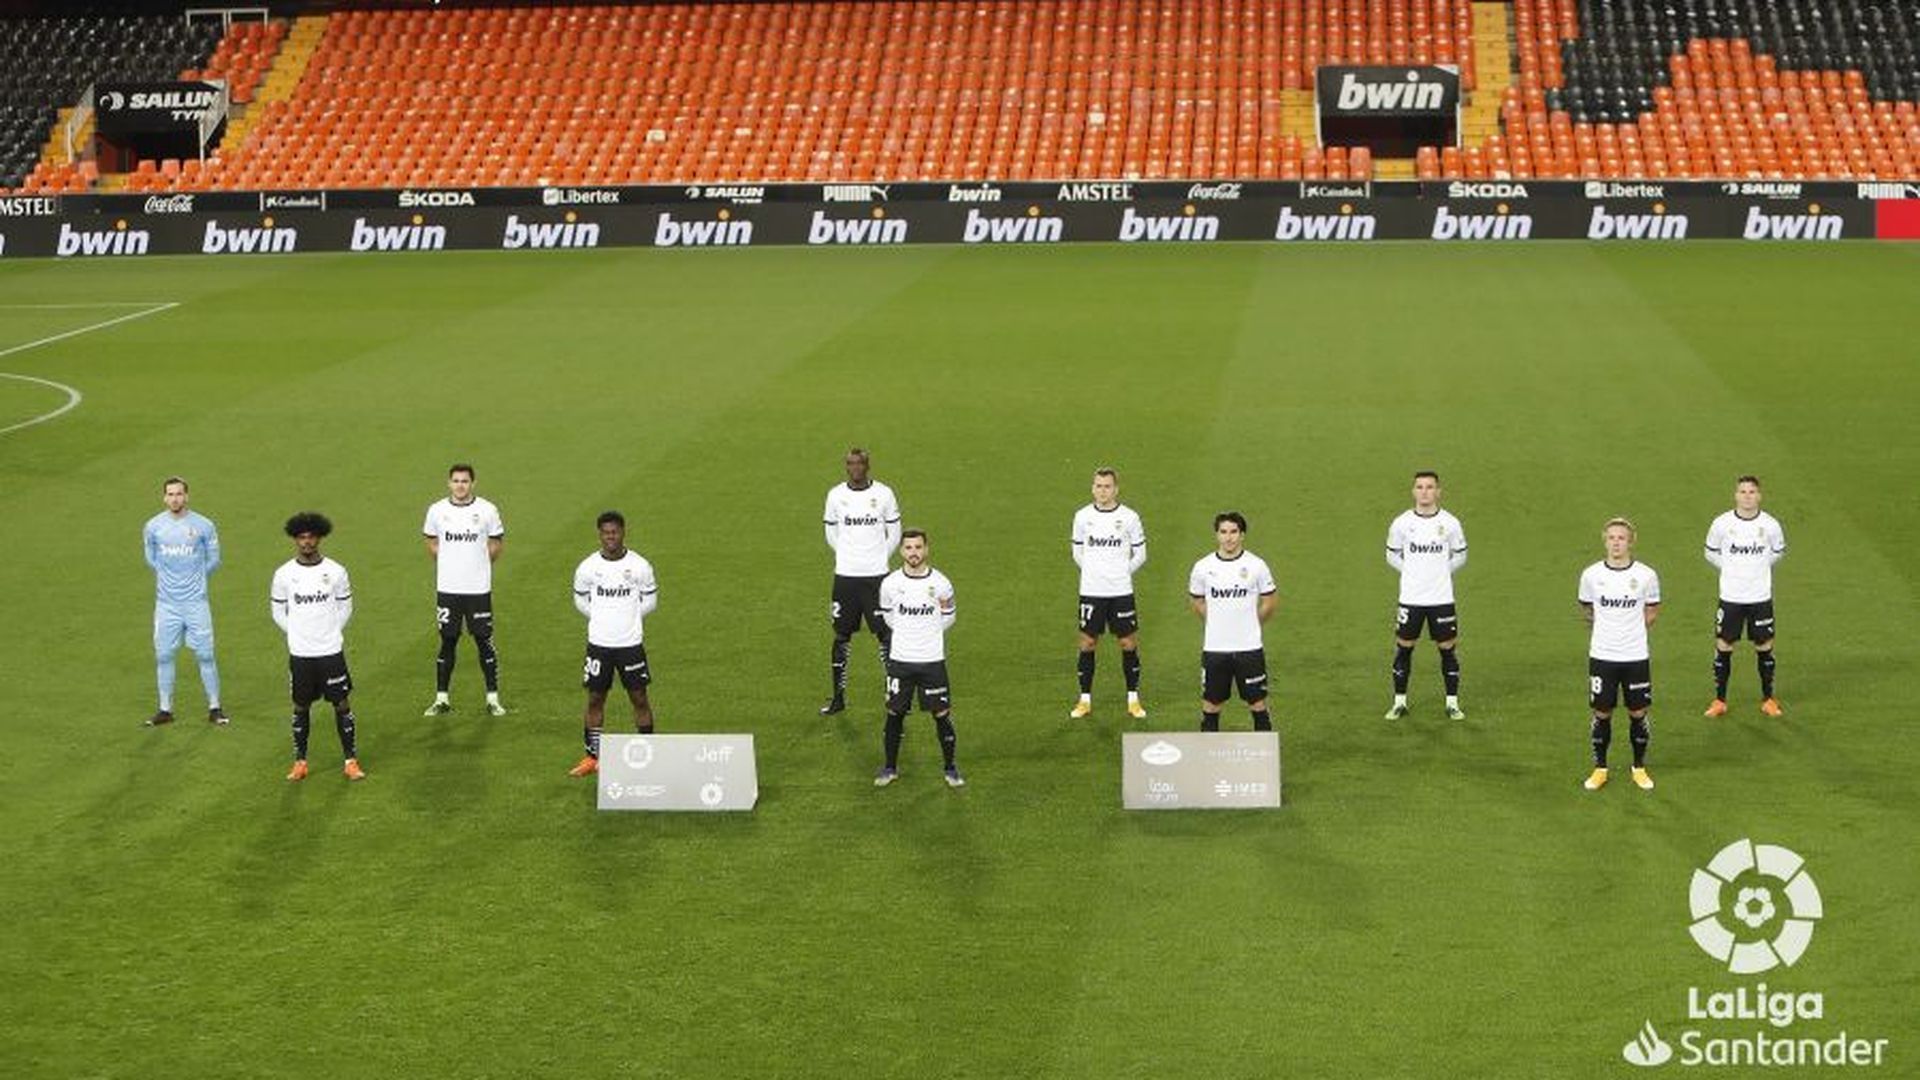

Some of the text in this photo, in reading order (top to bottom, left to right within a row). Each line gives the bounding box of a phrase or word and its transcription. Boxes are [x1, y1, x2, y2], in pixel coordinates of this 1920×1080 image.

[1337, 70, 1444, 110] bwin
[129, 91, 220, 109] SAILUN
[171, 110, 208, 121] TYR
[399, 189, 475, 207] ŠKODA
[560, 190, 619, 204] Libertex
[705, 187, 764, 197] SAILUN
[823, 185, 871, 202] PUMA
[949, 183, 1001, 202] bwin
[1058, 184, 1133, 201] AMSTEL
[1448, 181, 1528, 198] ŠKODA
[1602, 182, 1664, 198] Libertex
[1741, 183, 1802, 195] SAILUN
[0, 198, 54, 216] MSTEL
[503, 212, 600, 248] bwin
[654, 209, 753, 246] bwin
[808, 207, 908, 243] bwin
[964, 206, 1063, 242] bwin
[1119, 205, 1219, 240] bwin
[1275, 204, 1376, 240] bwin
[1431, 204, 1532, 240] bwin
[1587, 203, 1688, 239] bwin
[1743, 203, 1844, 240] bwin
[57, 219, 149, 256] bwin
[202, 216, 297, 253] bwin
[351, 215, 446, 250] bwin
[445, 528, 479, 543] bwin
[1088, 535, 1122, 548] bwin
[1729, 542, 1765, 555] bwin
[294, 591, 330, 605] bwin
[596, 584, 631, 598] bwin
[1211, 584, 1248, 599] bwin
[898, 603, 935, 617] bwin
[1600, 595, 1638, 609] bwin
[1080, 603, 1094, 620] 17
[886, 675, 900, 694] 14
